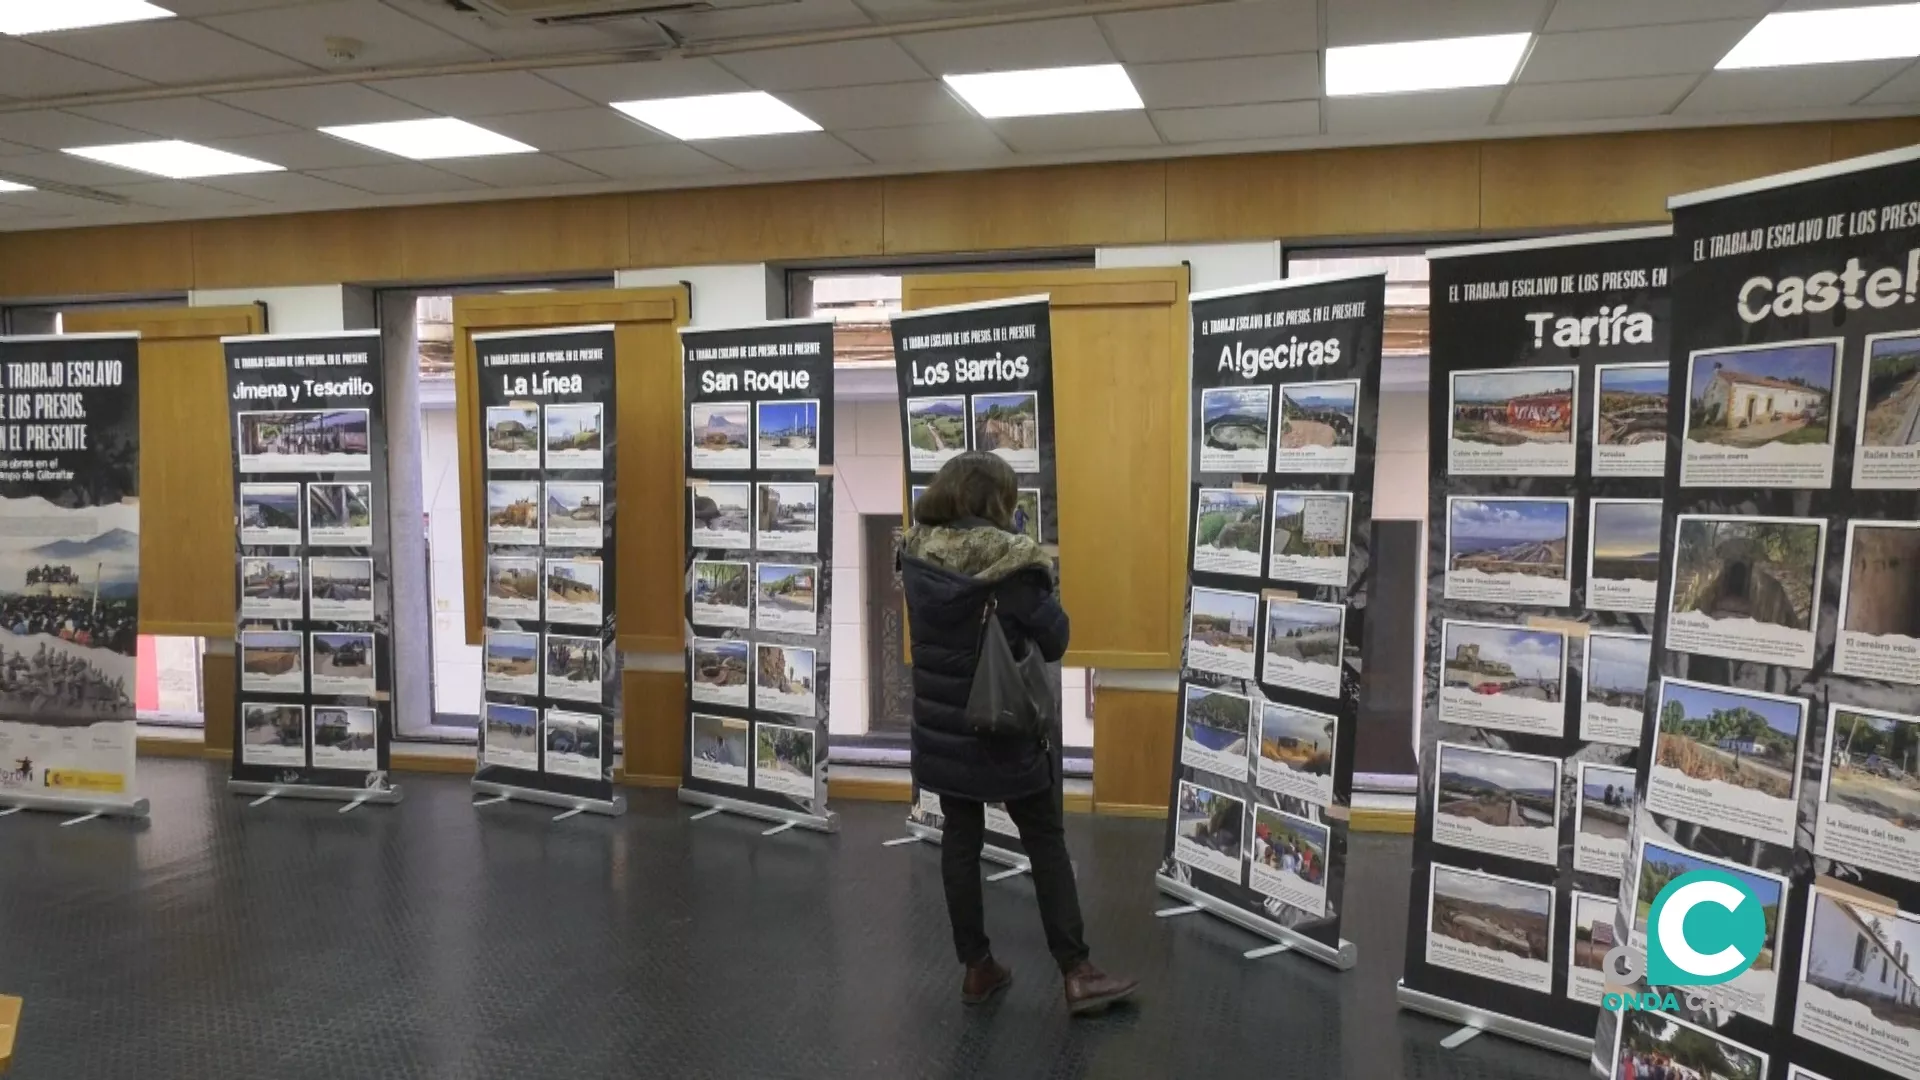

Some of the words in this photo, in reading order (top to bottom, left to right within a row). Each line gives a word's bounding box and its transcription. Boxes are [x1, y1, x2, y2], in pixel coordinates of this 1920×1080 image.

[1693, 238, 1706, 262] EL
[1709, 228, 1763, 260] TRABAJO
[1766, 217, 1823, 250] ESCLAVO
[1826, 213, 1845, 240] DE
[1849, 208, 1876, 236] LOS
[1449, 285, 1460, 303] EL
[1464, 280, 1509, 301] TRABAJO
[1512, 276, 1558, 298] ESCLAVO
[1561, 275, 1575, 293] DE
[1578, 273, 1599, 293] LOS
[1652, 267, 1668, 287] EN
[1202, 320, 1209, 335] EL
[1210, 316, 1235, 334] TRABAJO
[1236, 313, 1263, 331] ESCLAVO
[1264, 312, 1272, 328] DE
[1273, 310, 1285, 327] LOS
[1313, 305, 1322, 323] EN
[1323, 304, 1330, 321] EL
[1331, 301, 1367, 320] PRESENTE
[1525, 304, 1654, 349] Tarifa
[902, 337, 909, 351] EL
[909, 335, 930, 350] TRABAJO
[930, 332, 953, 348] ESCLAVO
[953, 332, 960, 346] DE
[961, 330, 970, 345] LOS
[993, 327, 1002, 342] EN
[1002, 326, 1008, 341] EL
[1008, 324, 1036, 340] PRESENTE
[912, 360, 950, 386] Los
[955, 351, 1030, 383] Barrios
[1217, 335, 1342, 379] Algeciras
[8, 361, 64, 389] TRABAJO
[67, 359, 122, 388] ESCLAVO
[503, 373, 528, 396] La
[531, 369, 583, 395] Línea
[701, 370, 739, 393] San
[743, 369, 810, 395] Roque
[232, 380, 288, 400] Jimena
[290, 384, 300, 403] y
[303, 376, 374, 397] Tesorillo
[9, 393, 31, 420] LOS
[9, 424, 22, 451] EL
[26, 423, 88, 451] PRESENTE
[9, 458, 34, 469] obras
[35, 460, 48, 469] en
[22, 470, 35, 480] de
[36, 469, 75, 481] Gibraltar
